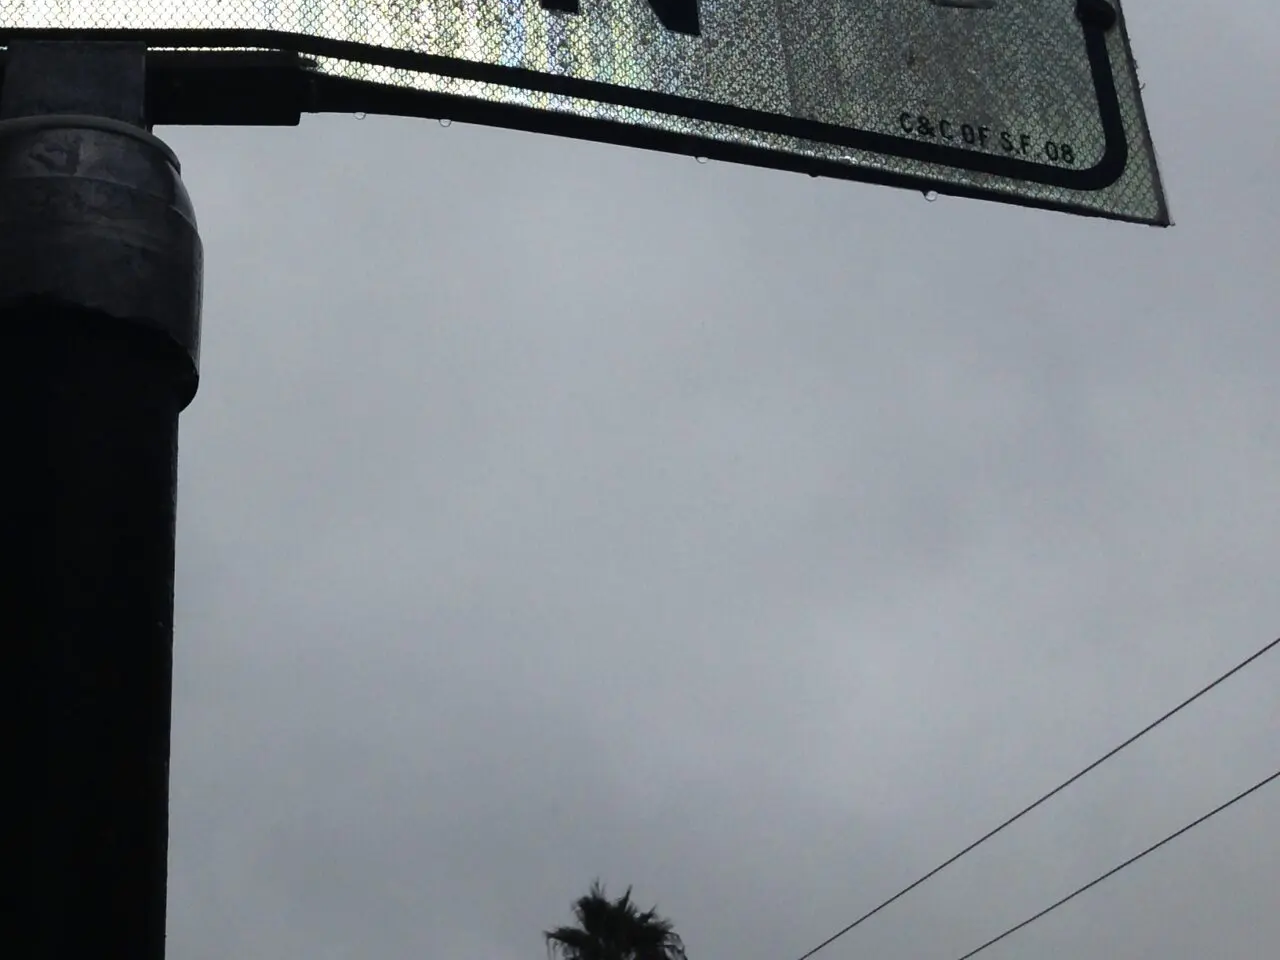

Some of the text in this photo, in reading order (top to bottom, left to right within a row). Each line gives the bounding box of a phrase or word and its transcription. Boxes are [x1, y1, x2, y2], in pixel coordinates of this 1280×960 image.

[900, 112, 953, 140] C&C
[962, 124, 991, 148] OF
[1045, 141, 1075, 165] 08
